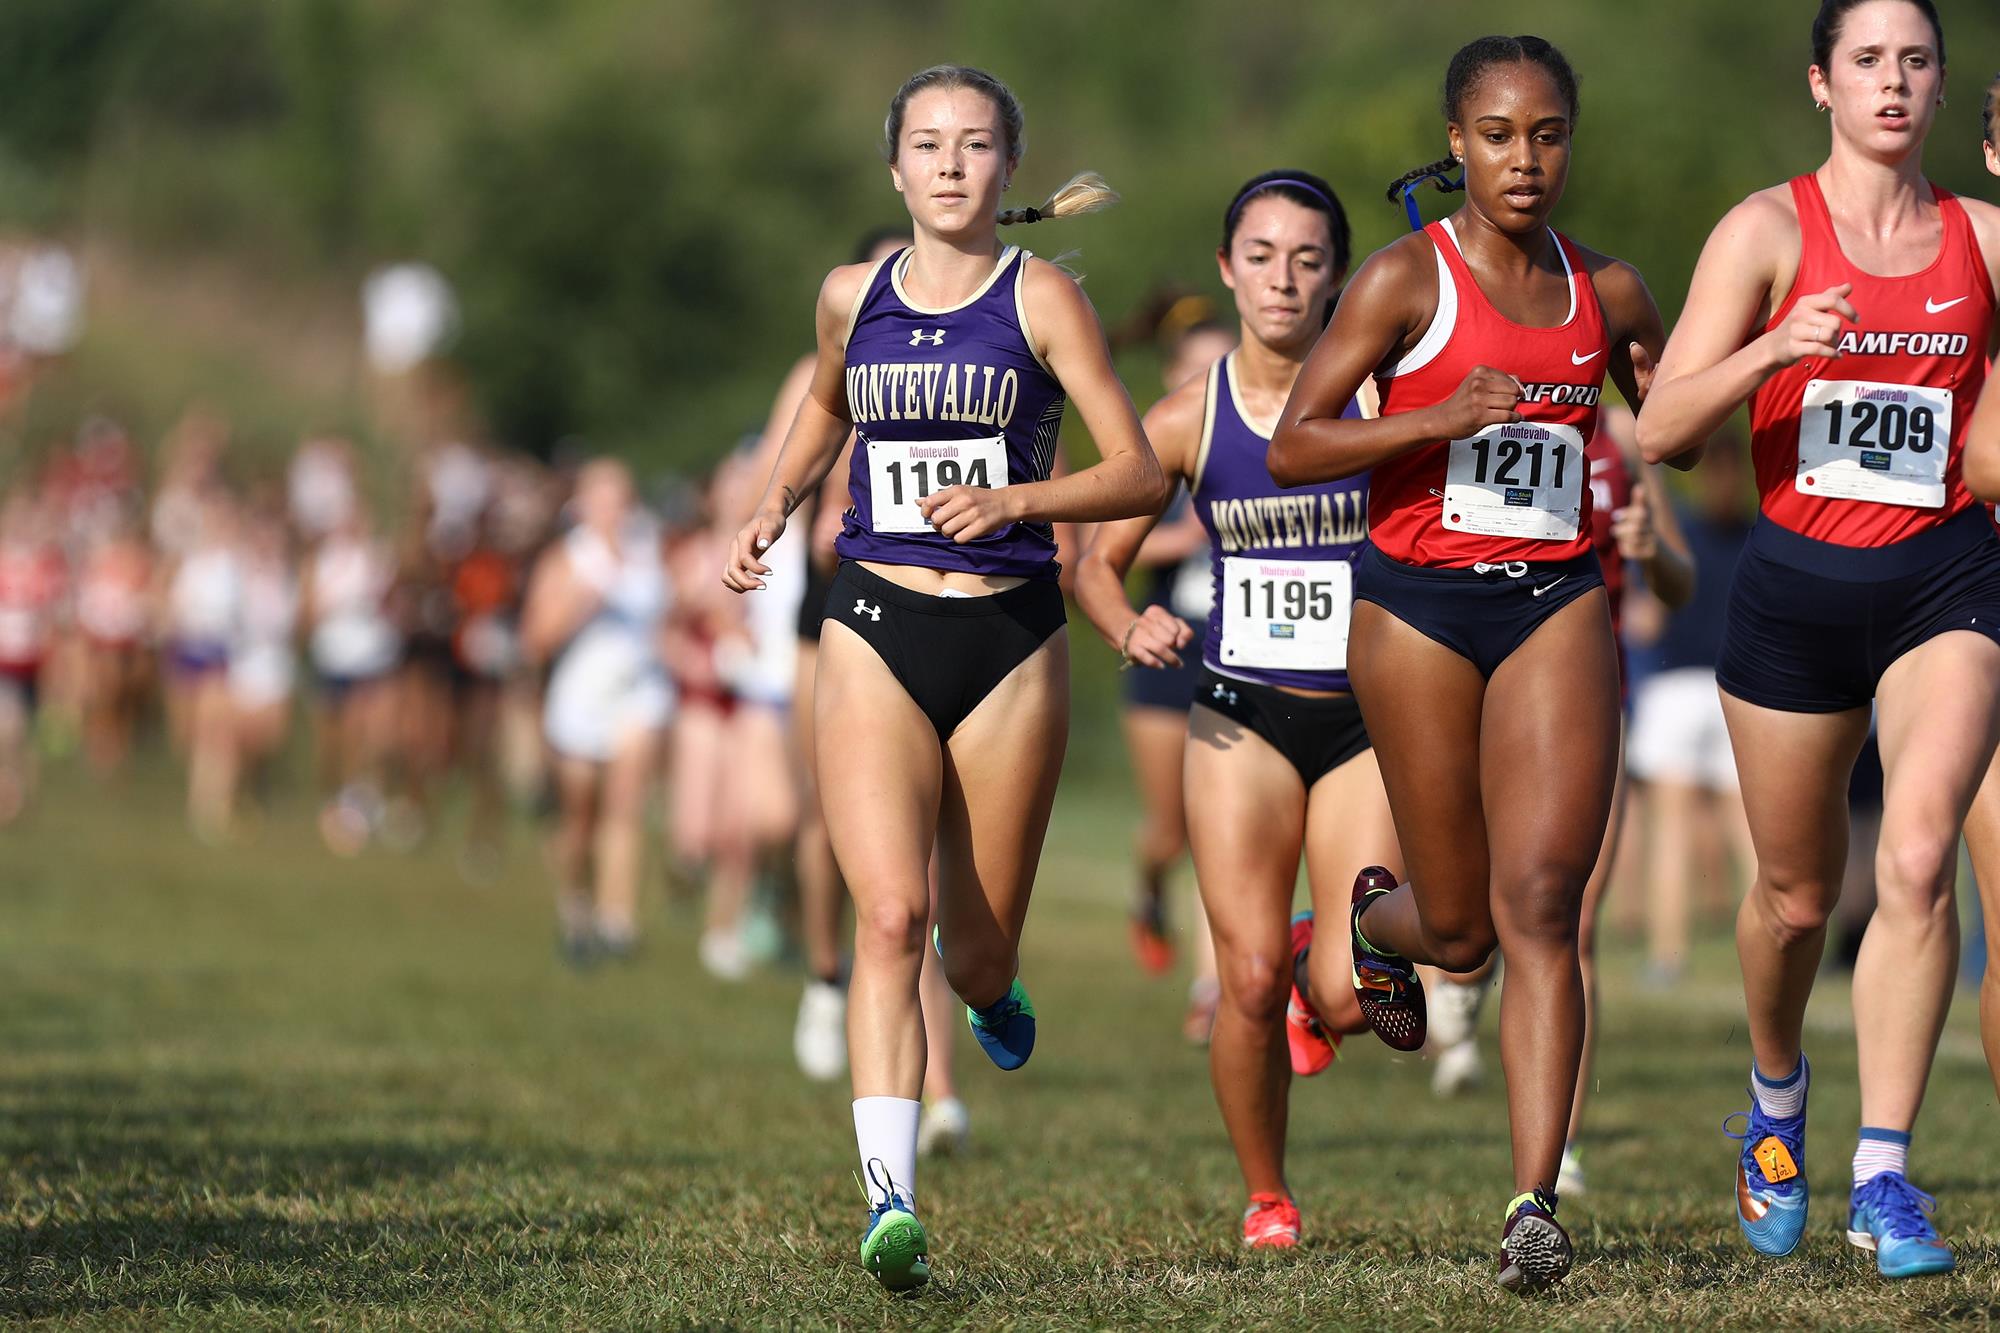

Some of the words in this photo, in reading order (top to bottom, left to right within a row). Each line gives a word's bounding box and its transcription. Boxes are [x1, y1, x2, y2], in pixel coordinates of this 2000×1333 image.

[1837, 331, 1969, 356] AMFORD
[845, 362, 1019, 429] MONTEVALLO
[1854, 385, 1908, 403] Montevallo
[1500, 425, 1550, 441] Montevallo
[1824, 399, 1935, 454] 1209
[909, 445, 959, 459] Montevallo
[1471, 438, 1568, 489] 1211
[886, 458, 992, 505] 1194
[1210, 490, 1366, 552] MONTEVALL
[1238, 579, 1333, 621] 1195
